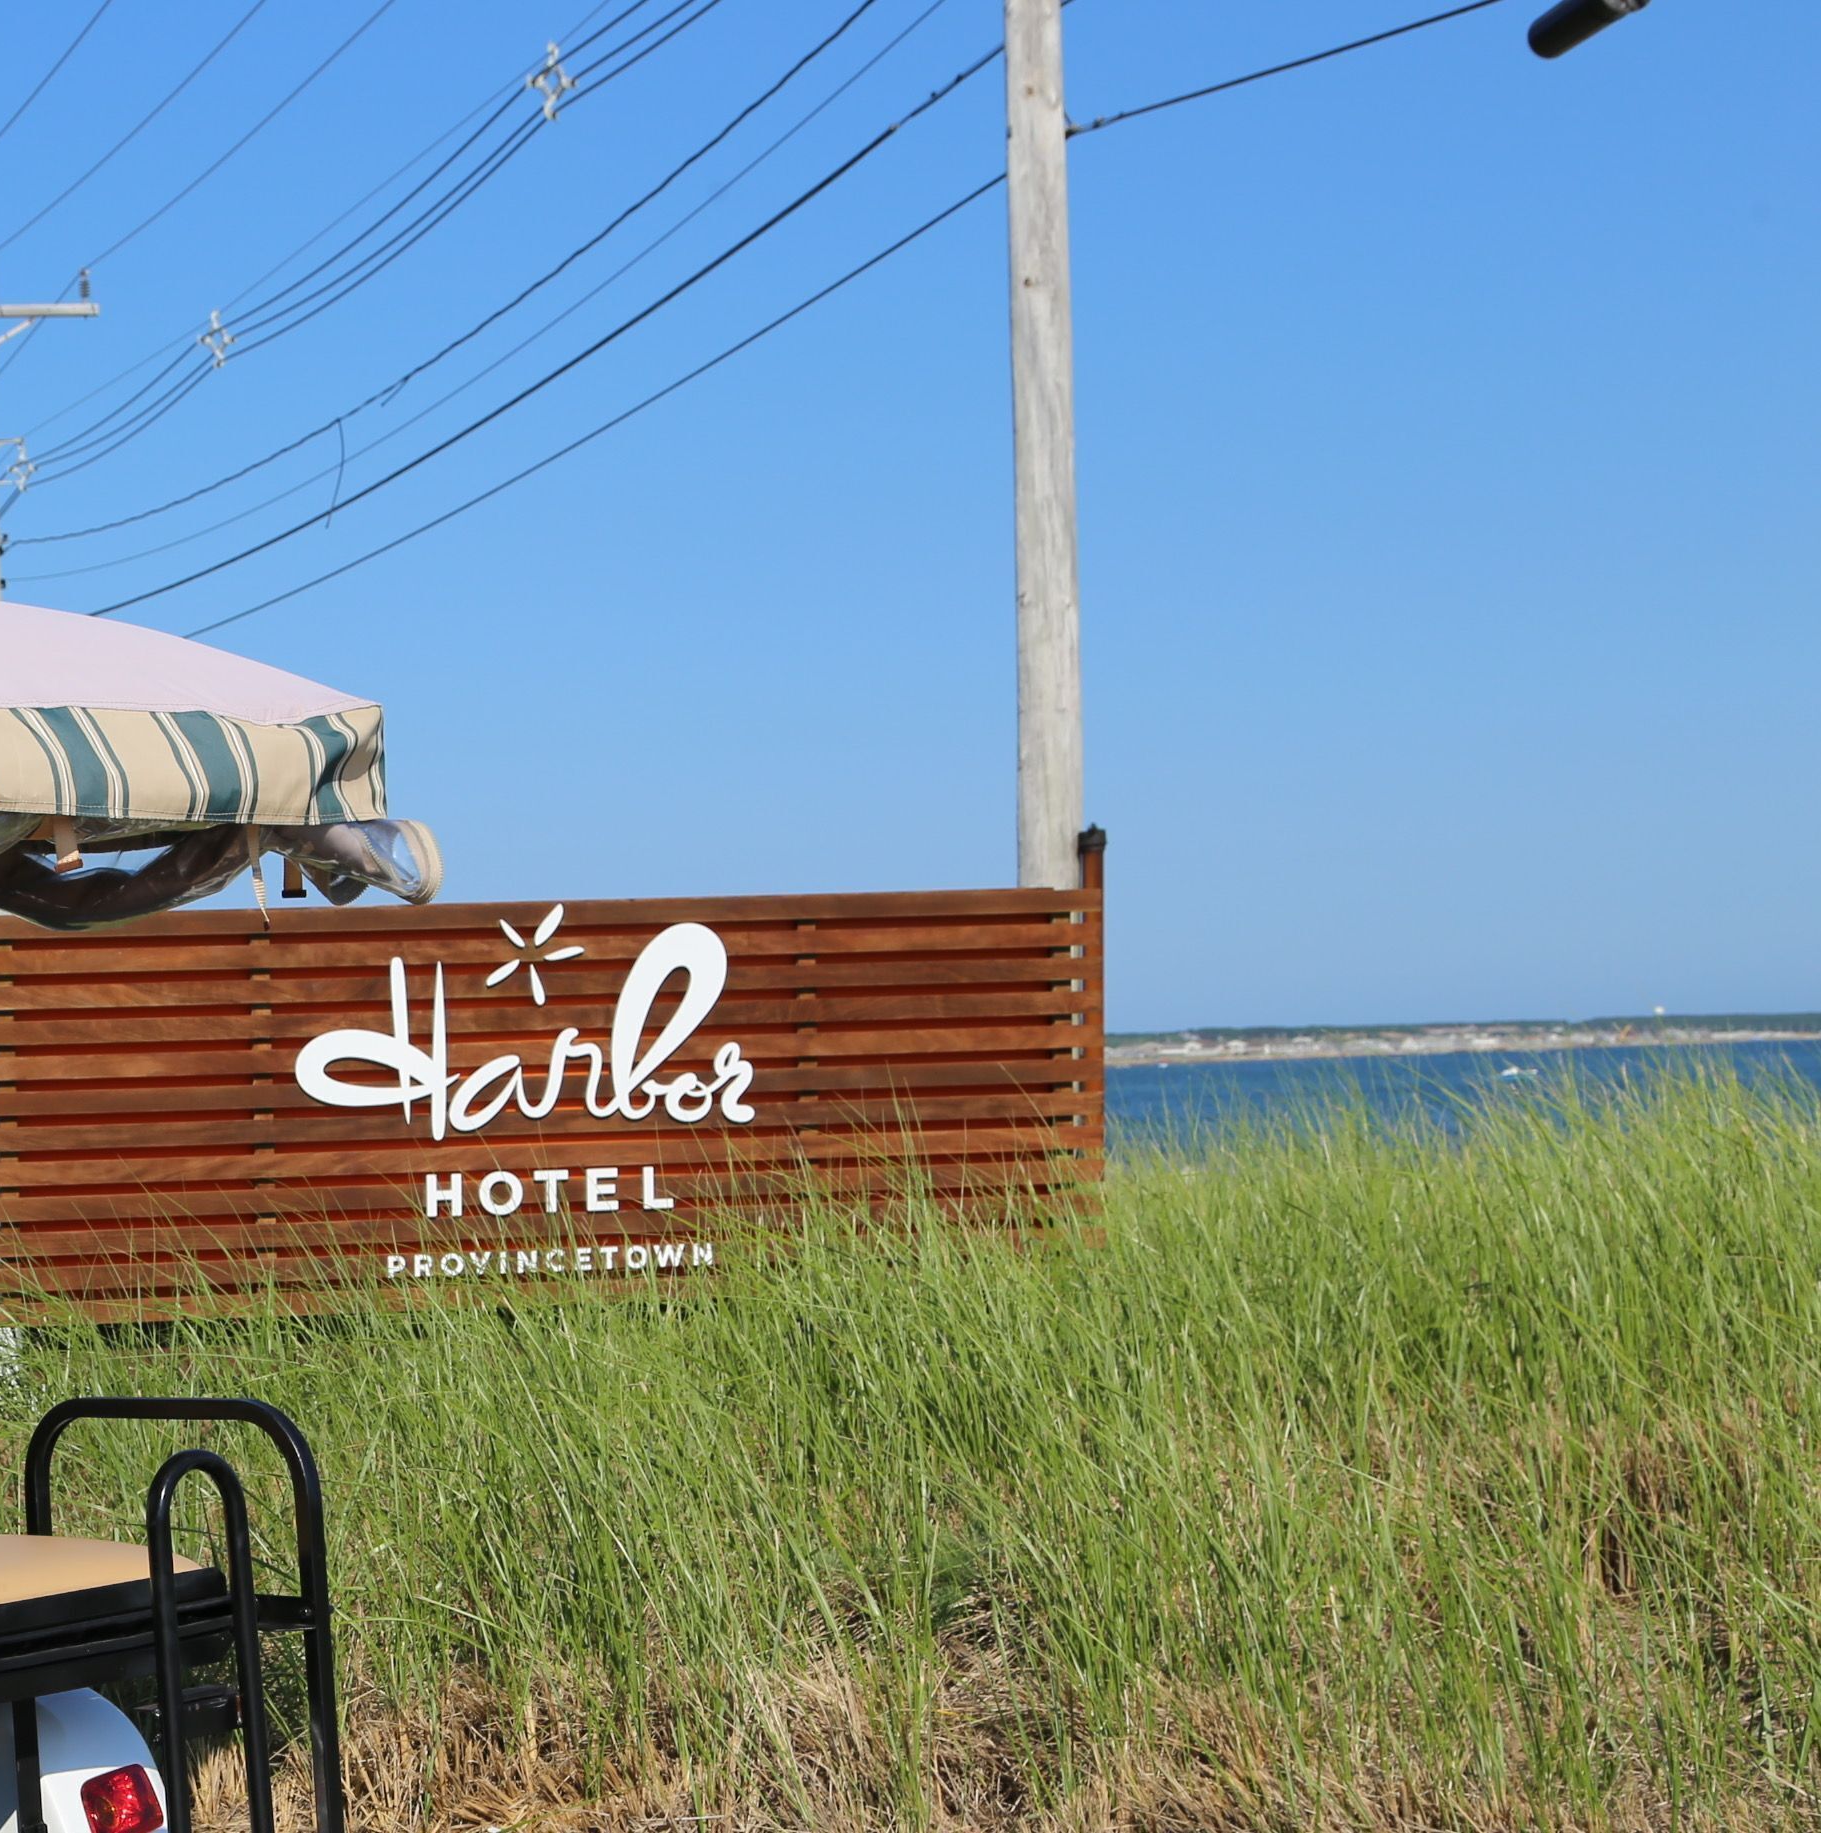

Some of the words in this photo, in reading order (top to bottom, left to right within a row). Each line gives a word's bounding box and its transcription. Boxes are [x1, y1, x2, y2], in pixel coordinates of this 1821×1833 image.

[295, 922, 756, 1142] Harbor
[425, 1165, 675, 1218] HOTEL
[386, 1242, 715, 1279] PROVINCETOWN
